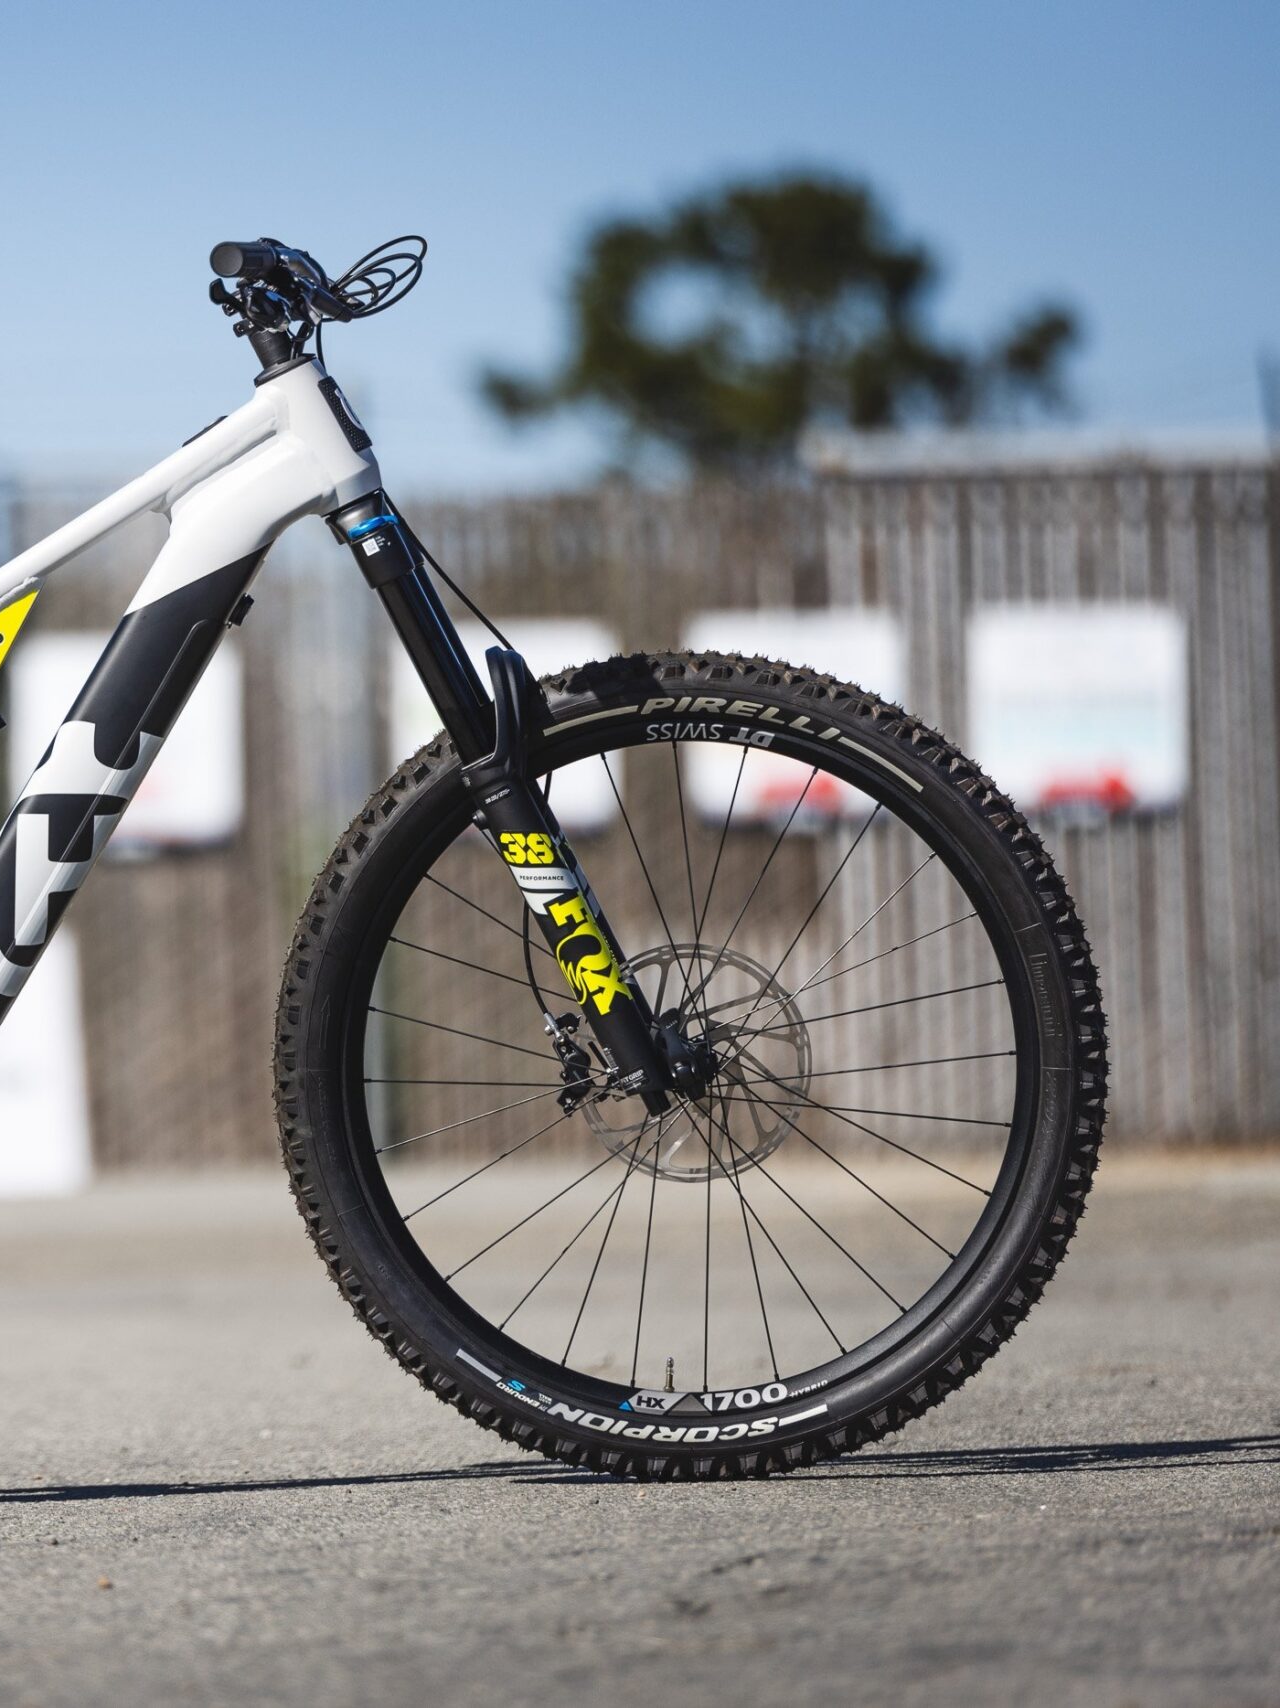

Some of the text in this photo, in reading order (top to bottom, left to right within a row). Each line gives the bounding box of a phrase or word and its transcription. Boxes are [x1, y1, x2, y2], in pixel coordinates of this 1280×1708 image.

[641, 697, 840, 741] PIRELLI
[646, 723, 775, 748] DT SWISS
[500, 833, 554, 864] 38
[548, 891, 633, 1016] FOX
[496, 1382, 540, 1408] ENDURO
[507, 1380, 526, 1392] S
[635, 1379, 829, 1412] HX 1700 HYBRID
[546, 1402, 780, 1443] SCORPION
